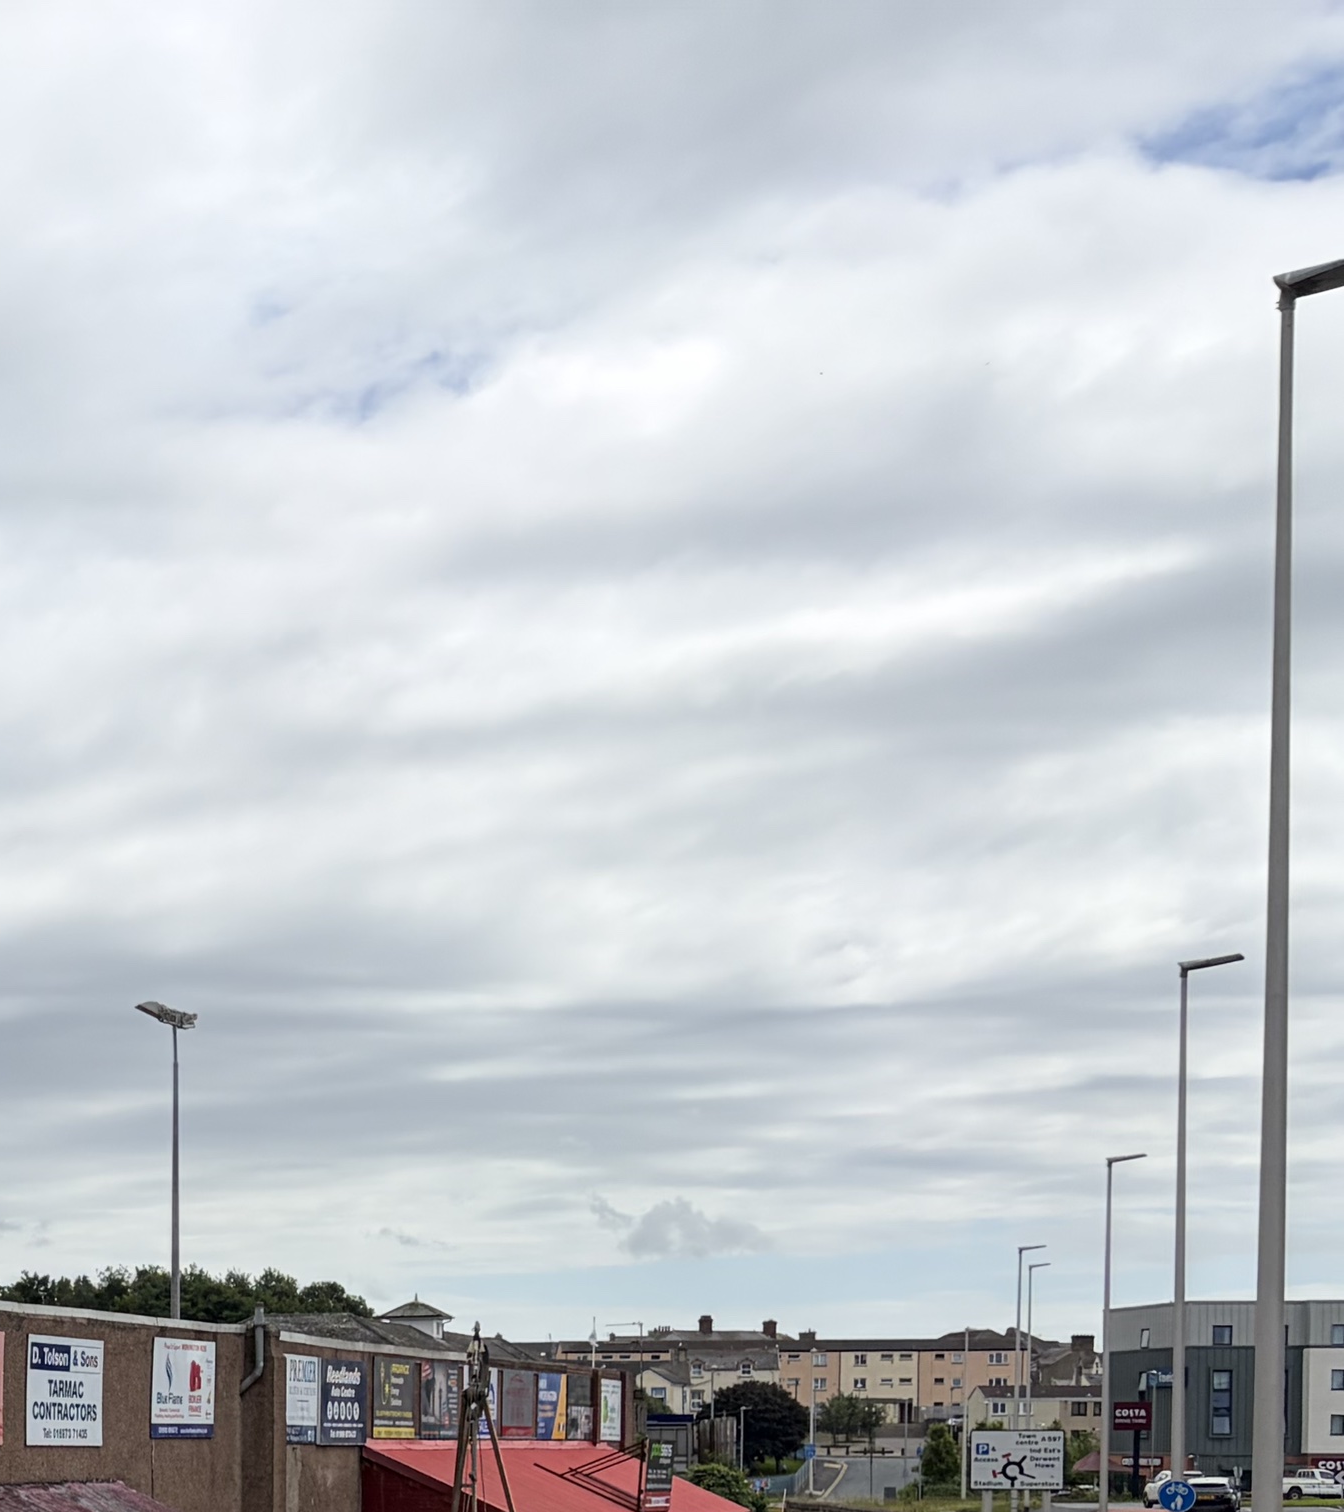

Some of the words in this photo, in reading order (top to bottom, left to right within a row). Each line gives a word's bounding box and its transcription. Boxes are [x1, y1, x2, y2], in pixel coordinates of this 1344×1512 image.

[32, 1346, 41, 1364] D.
[43, 1347, 69, 1367] Tolson
[73, 1350, 78, 1367] &
[80, 1351, 98, 1368] Sons
[326, 1365, 361, 1385] Reedlands
[48, 1379, 84, 1399] TARMAC
[331, 1385, 341, 1397] Auto
[341, 1386, 356, 1398] Centre
[32, 1401, 97, 1422] CONTRACTORS
[1115, 1408, 1147, 1417] COSTA
[43, 1428, 52, 1439] Tel:
